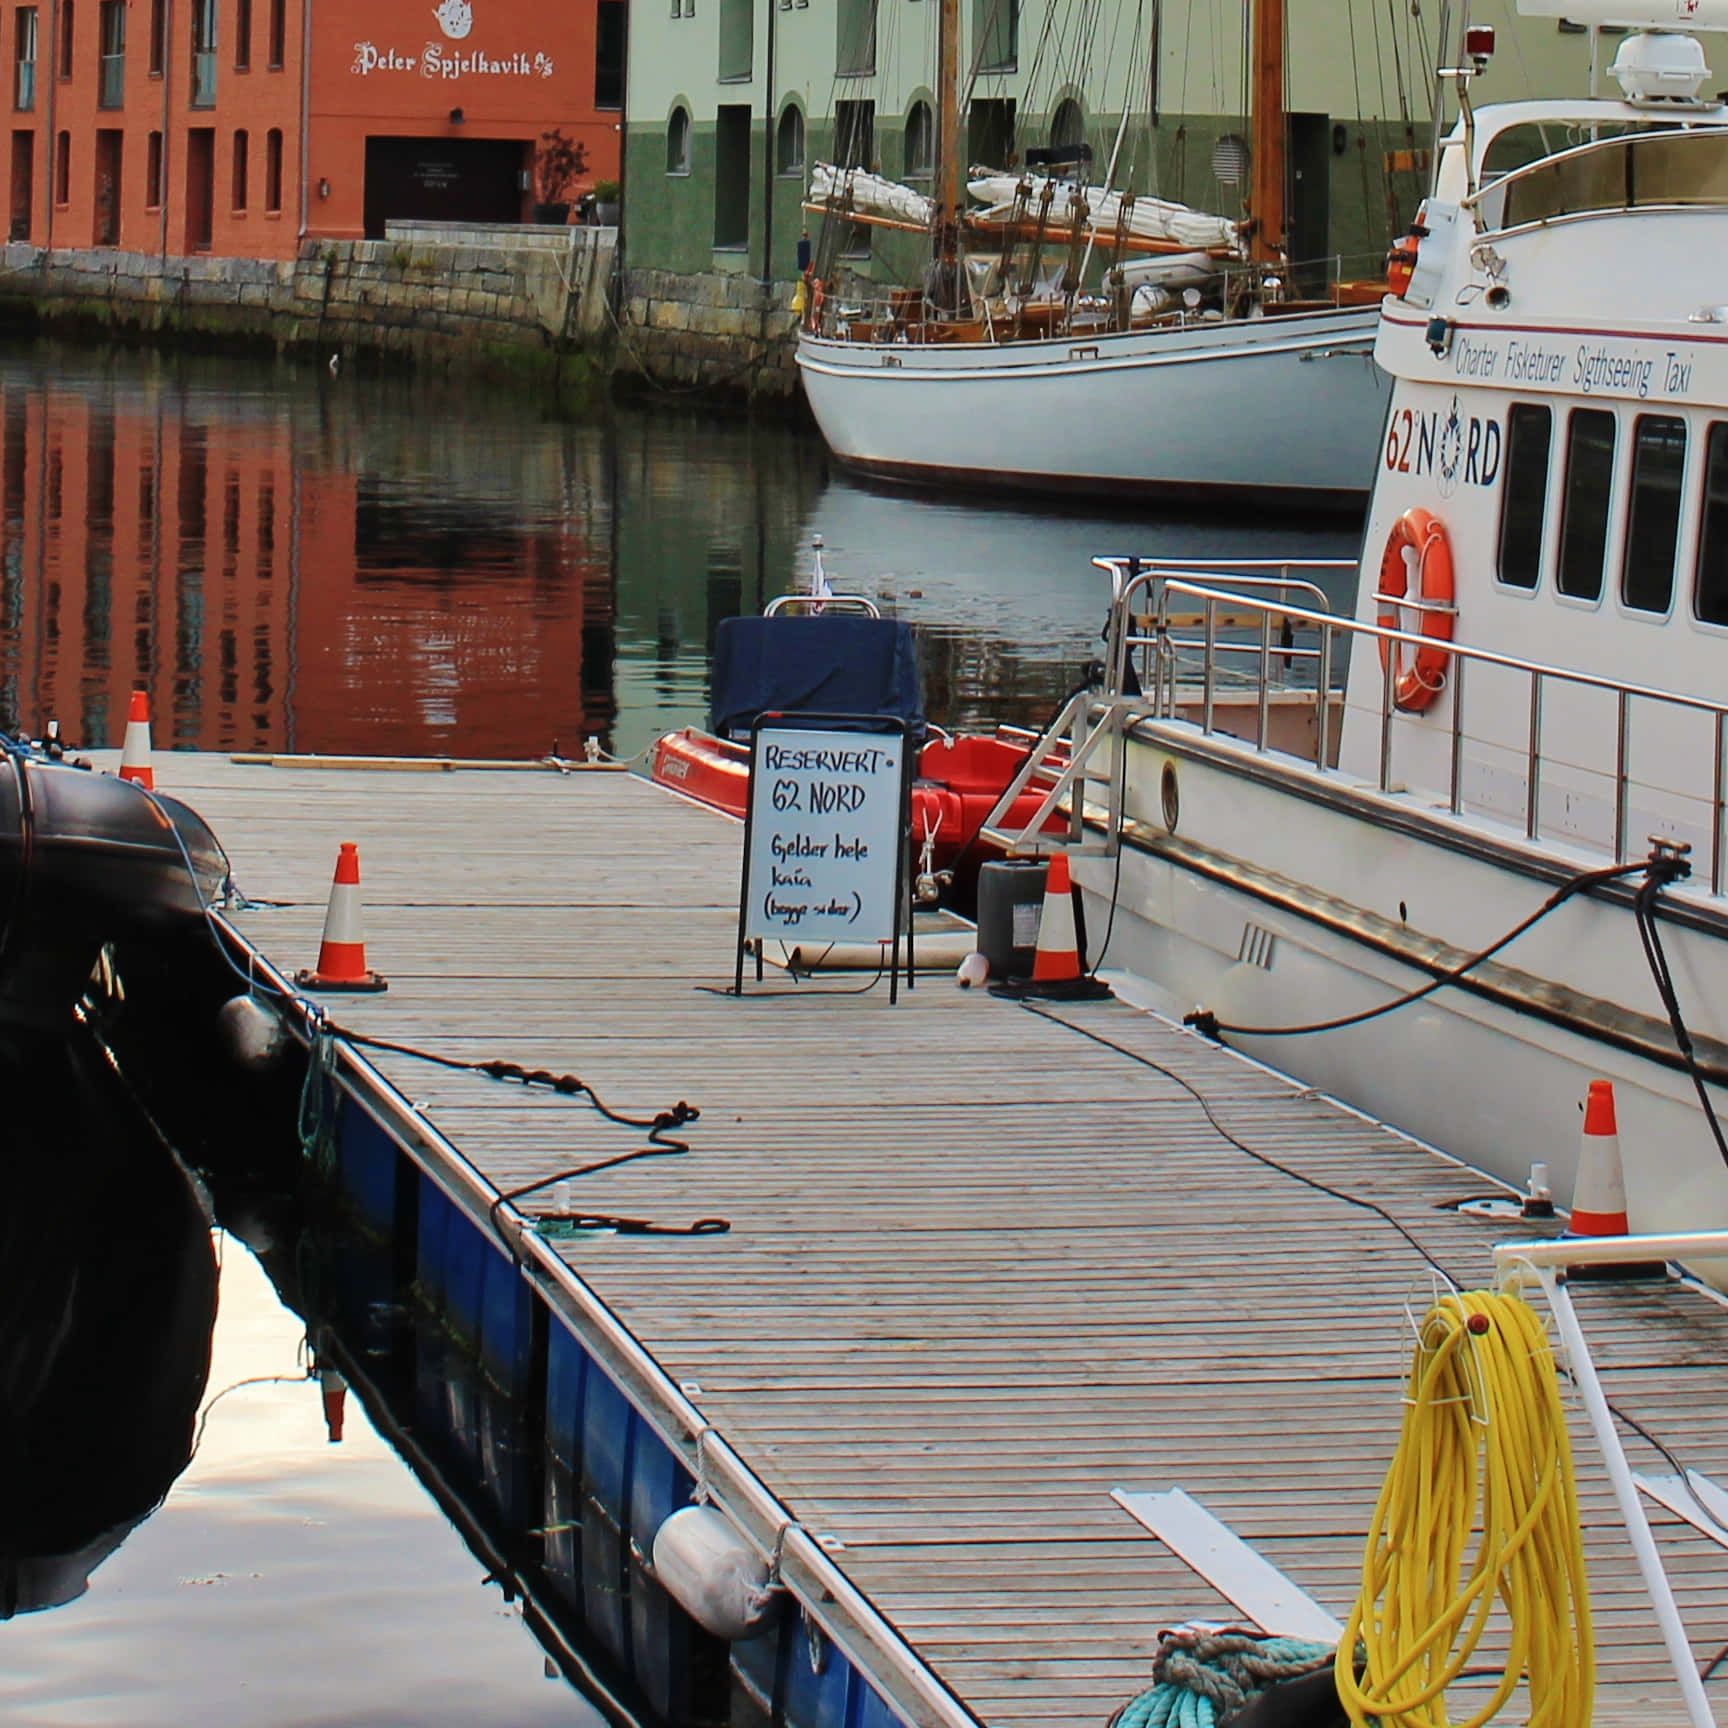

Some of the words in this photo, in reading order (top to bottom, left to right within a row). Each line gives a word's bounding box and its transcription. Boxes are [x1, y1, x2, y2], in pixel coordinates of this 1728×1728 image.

[351, 41, 416, 75] Peter
[421, 41, 531, 79] Spjelkavik
[1455, 337, 1498, 377] Charter
[1504, 341, 1566, 383] Fisketurer
[1573, 344, 1654, 398] Sigthseeing
[1663, 352, 1694, 393] Taxi
[765, 744, 885, 774] RESERVERT
[773, 778, 802, 812] 62
[810, 781, 866, 814] NORD
[771, 833, 829, 864] Gjelder
[834, 833, 869, 861] hele
[771, 866, 812, 887] kaia
